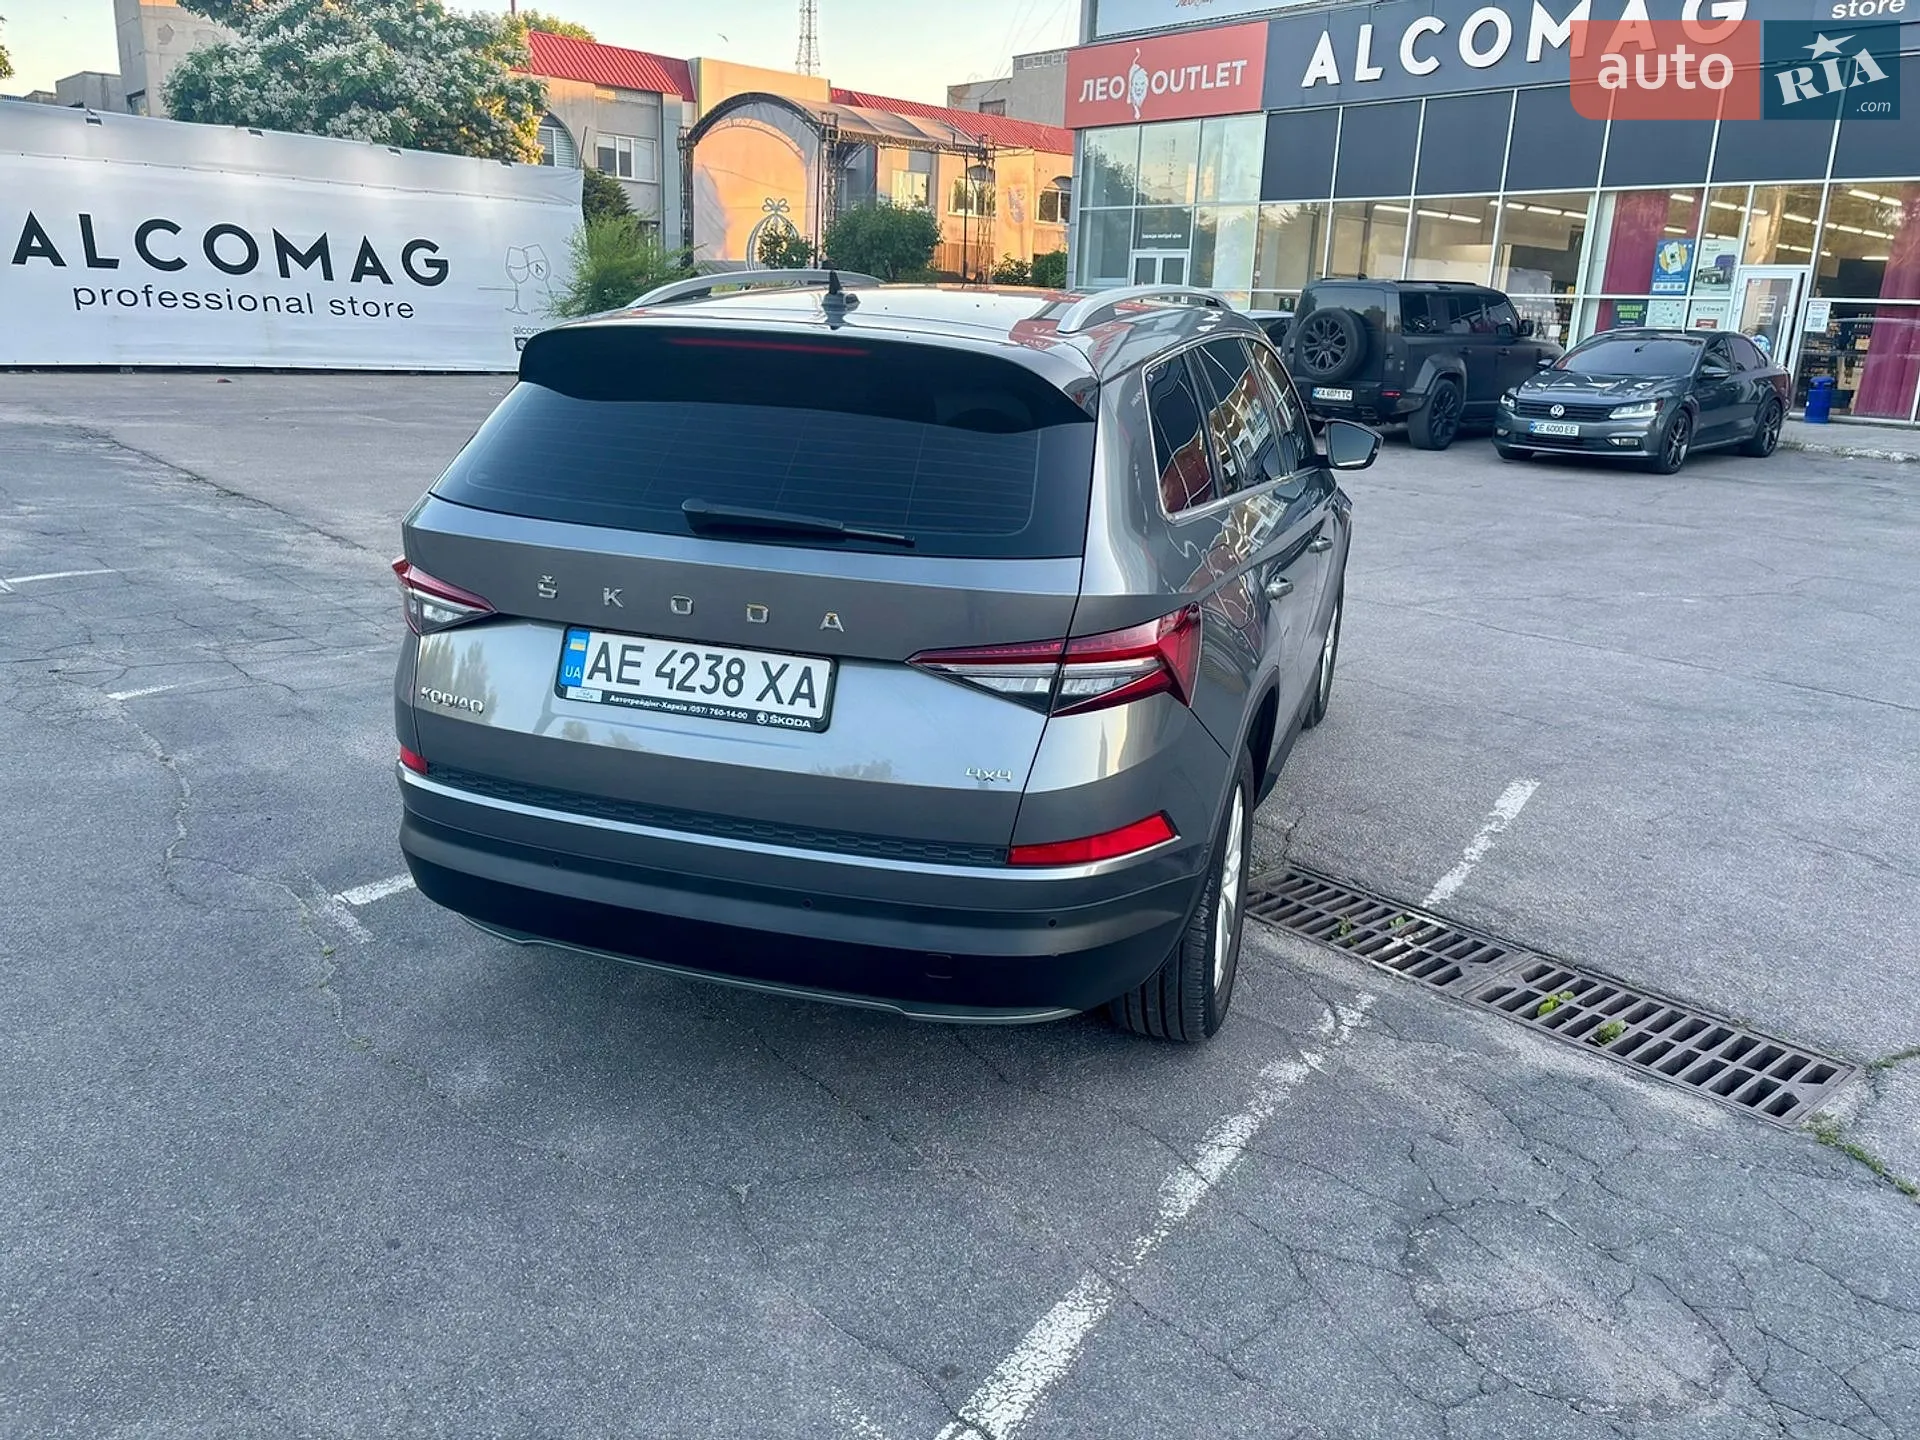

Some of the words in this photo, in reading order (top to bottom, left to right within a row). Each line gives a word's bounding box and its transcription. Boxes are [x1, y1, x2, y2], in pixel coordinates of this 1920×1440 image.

[1831, 0, 1905, 20] store
[1301, 0, 1748, 88] ALCOMAG
[1079, 75, 1126, 103] ЛЕО
[1150, 59, 1248, 96] OUTLET
[11, 210, 450, 287] ALCOMAG
[73, 285, 314, 315] professional
[329, 296, 415, 319] store
[565, 666, 582, 680] UA
[587, 641, 645, 686] AE
[654, 649, 746, 698] 4238
[755, 660, 817, 708] XA
[769, 713, 811, 728] ŠKODA
